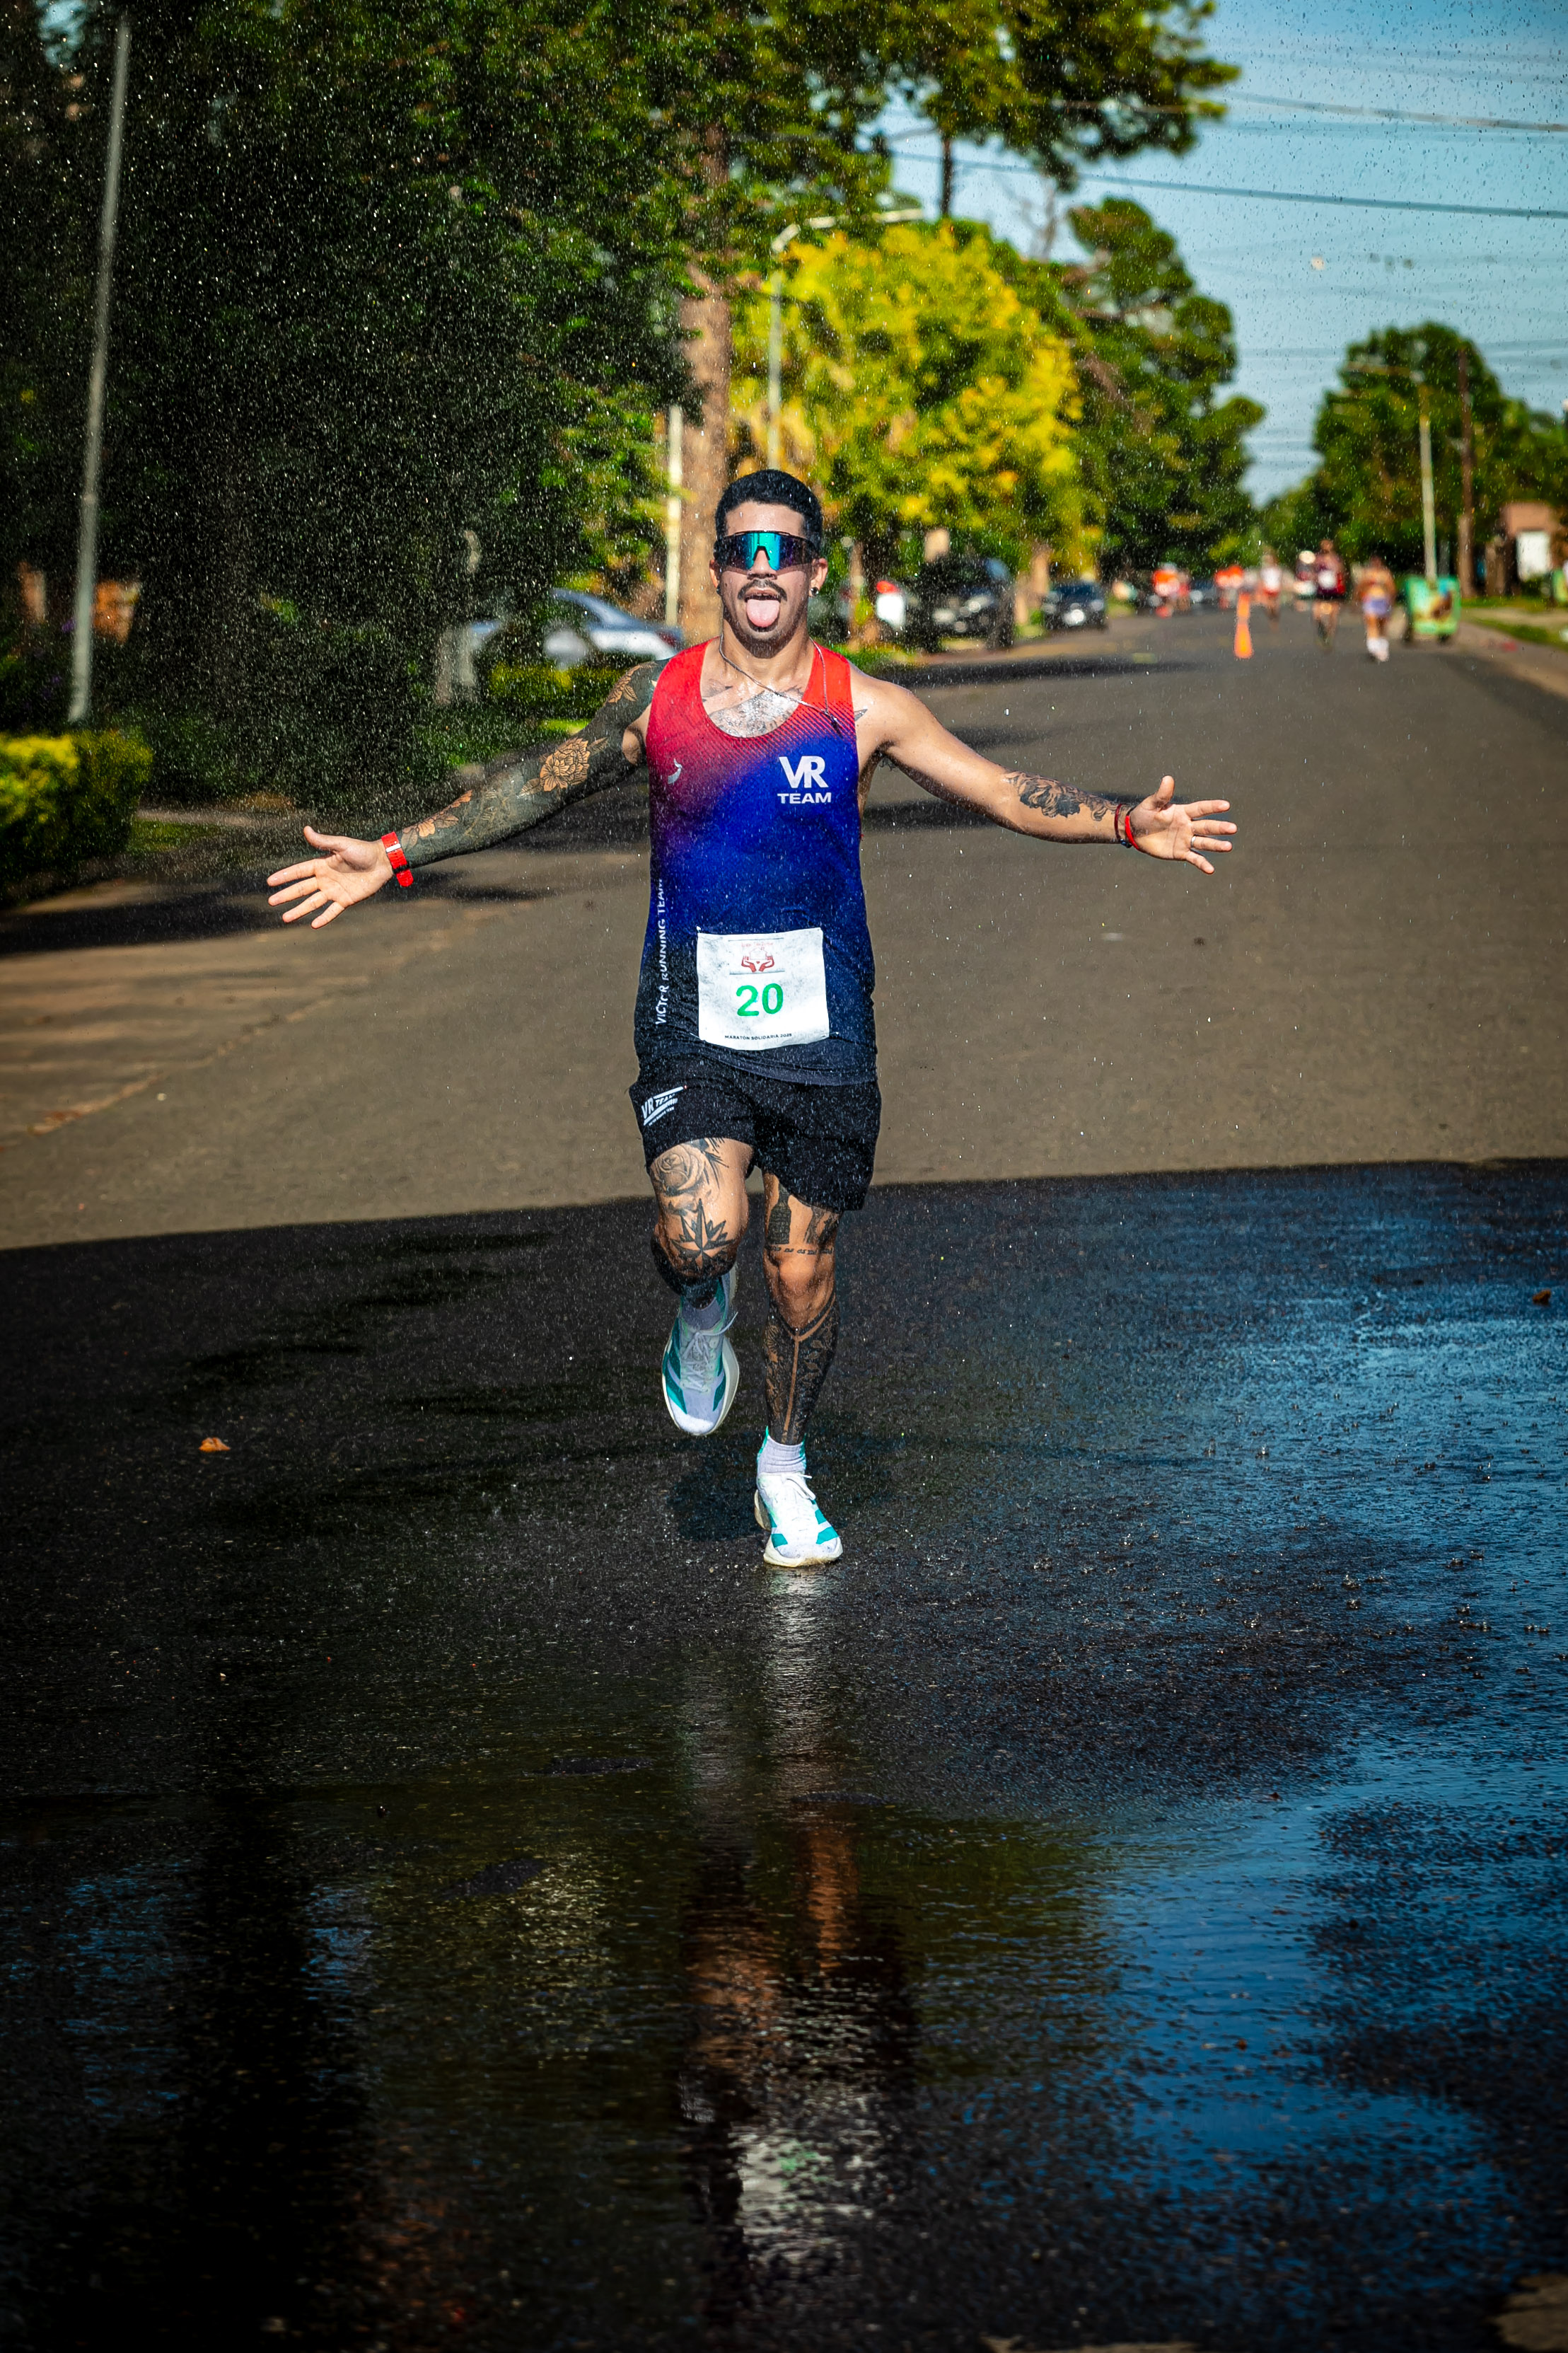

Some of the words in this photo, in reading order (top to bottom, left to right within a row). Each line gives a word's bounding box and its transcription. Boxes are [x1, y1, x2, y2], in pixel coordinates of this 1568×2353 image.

[779, 756, 829, 788] VR
[777, 792, 832, 804] TEAM
[658, 919, 669, 981] RUNNING
[736, 983, 784, 1017] 20
[641, 1097, 654, 1118] VR
